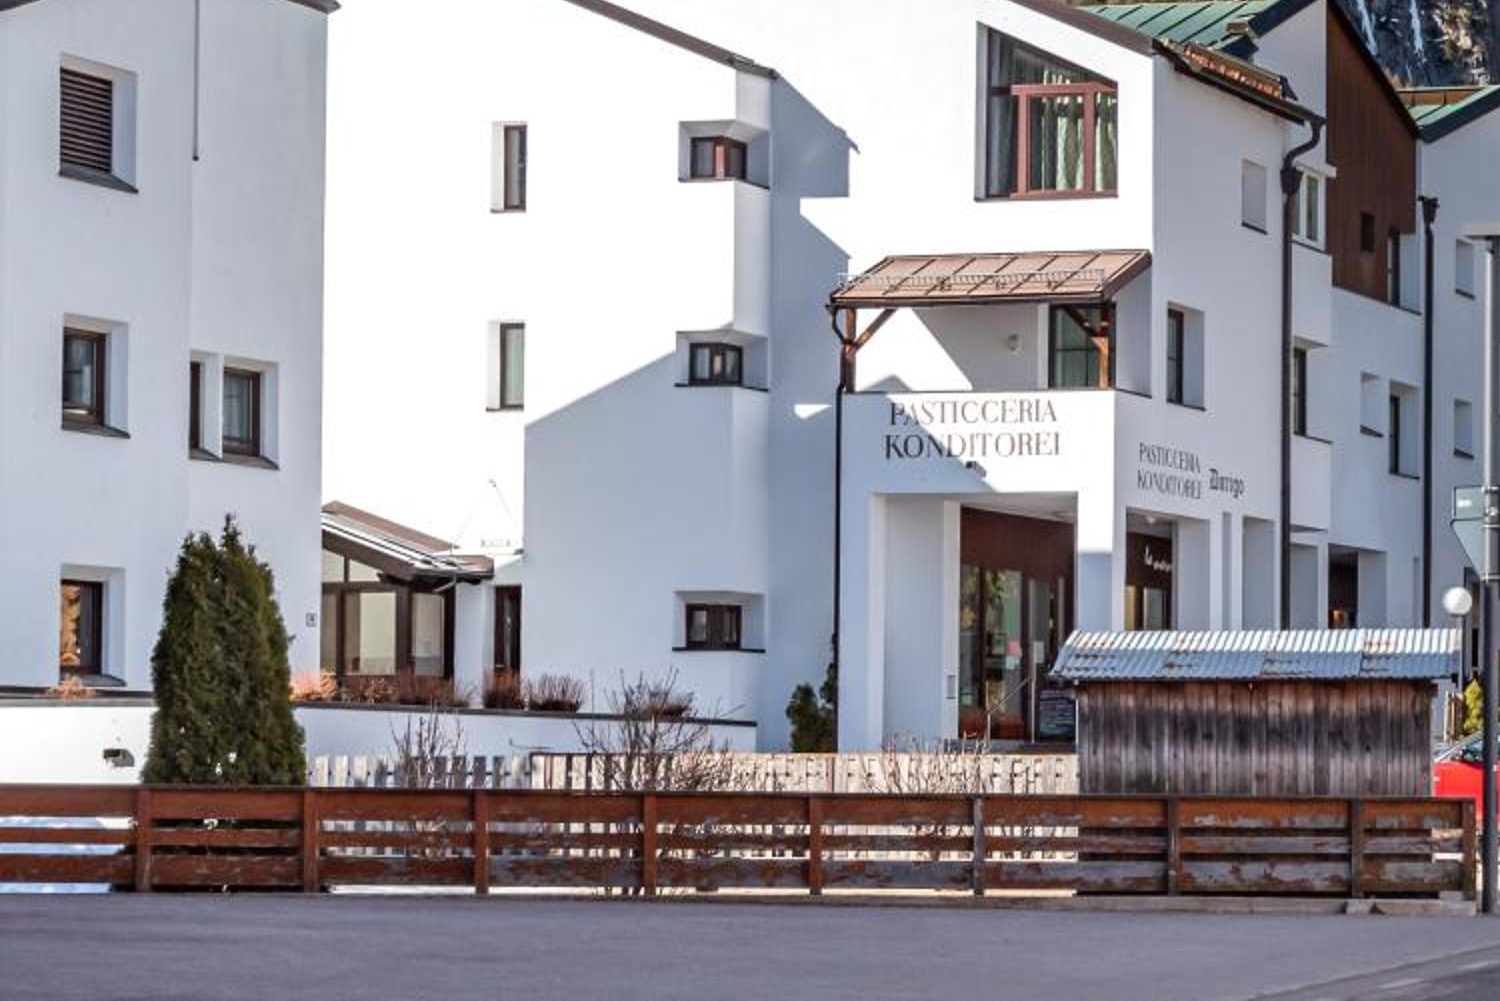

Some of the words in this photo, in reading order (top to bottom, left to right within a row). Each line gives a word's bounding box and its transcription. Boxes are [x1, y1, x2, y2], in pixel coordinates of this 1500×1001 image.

[889, 399, 1057, 425] PASTICCERIA
[885, 431, 1060, 459] KONDITOREI
[1139, 442, 1201, 474] PASTICCERIA
[1137, 470, 1201, 499] KONDITOREI
